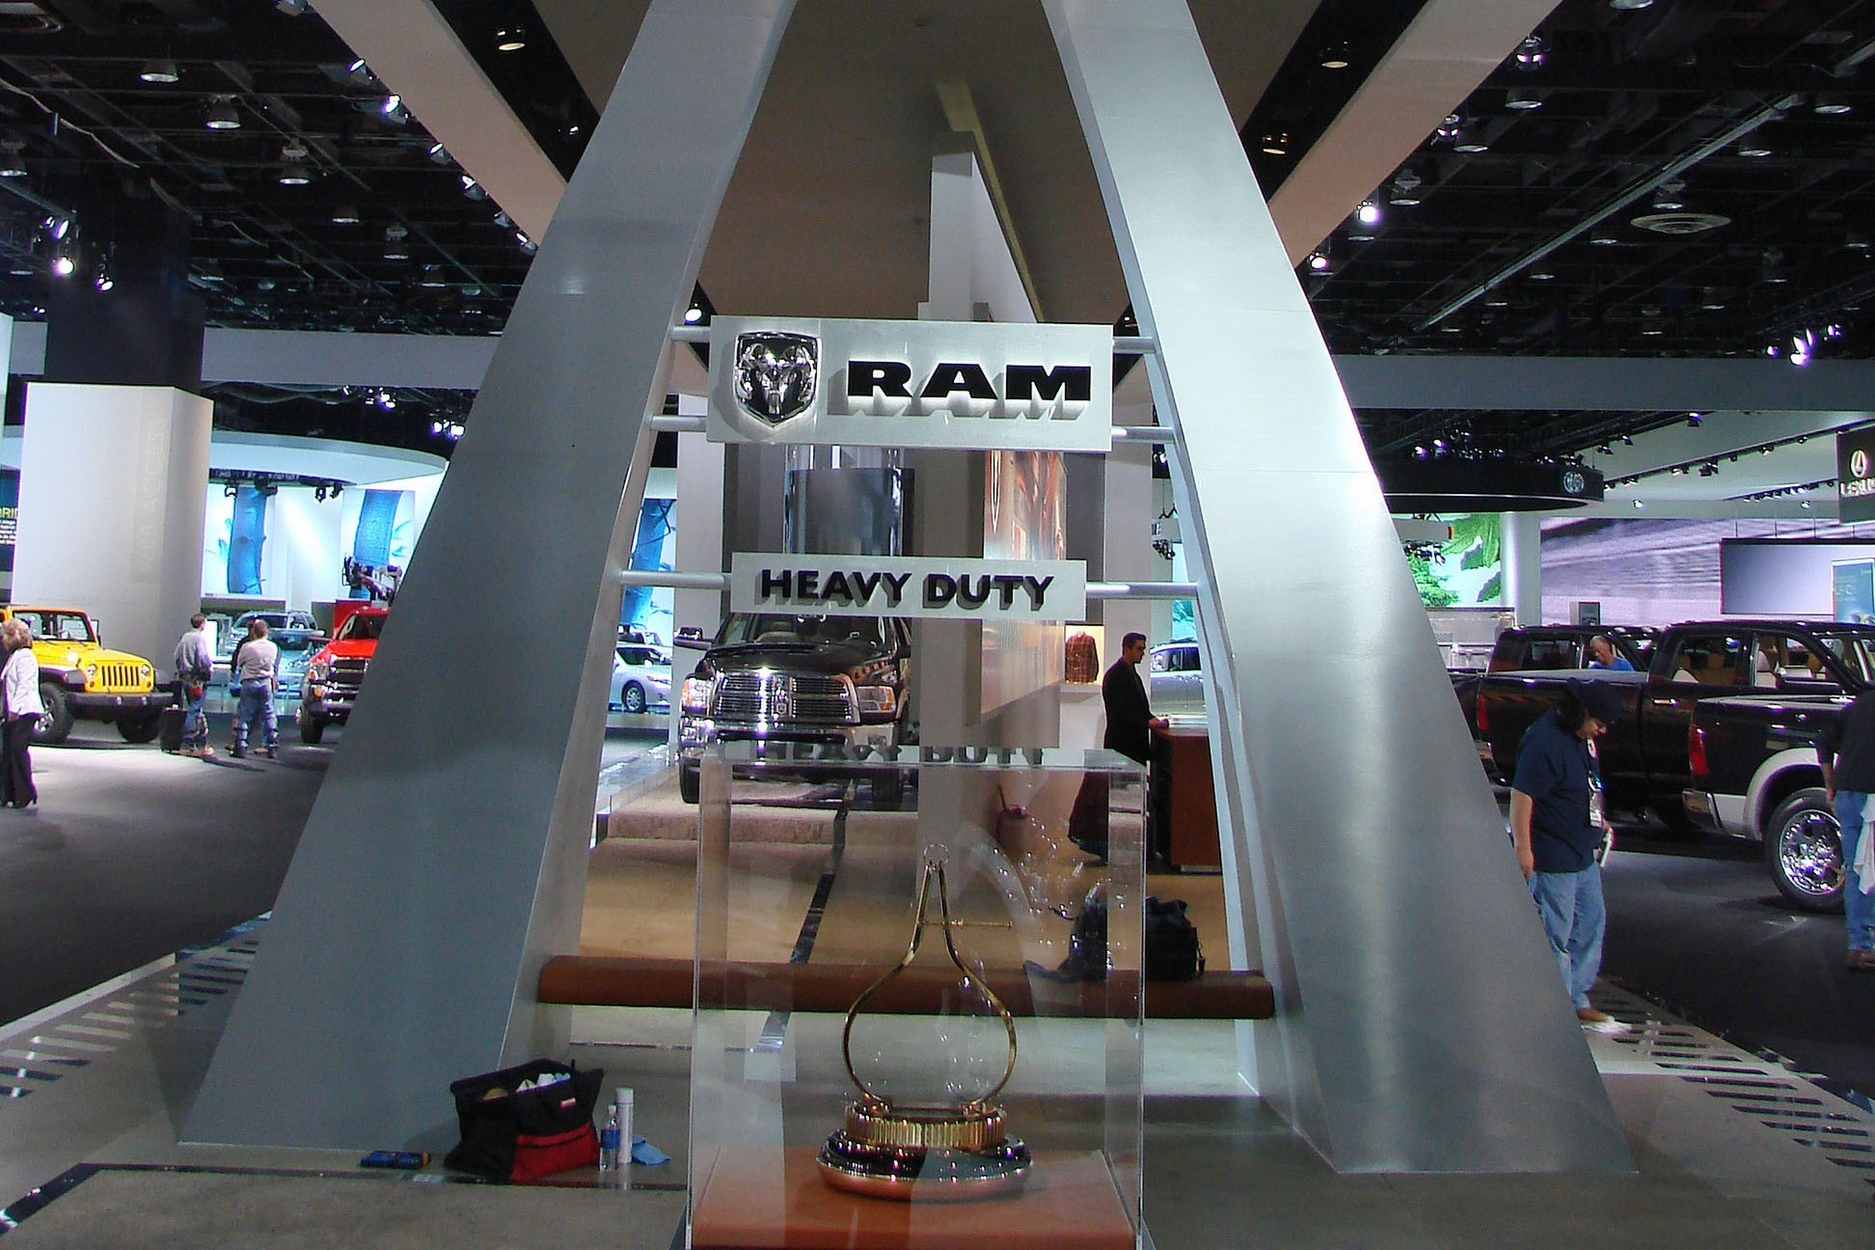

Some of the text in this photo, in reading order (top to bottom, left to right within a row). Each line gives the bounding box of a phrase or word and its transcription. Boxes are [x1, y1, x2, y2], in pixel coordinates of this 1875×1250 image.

[848, 360, 1091, 403] RAM
[143, 418, 167, 513] ACCESS
[758, 569, 1054, 608] HEAVY DUTY
